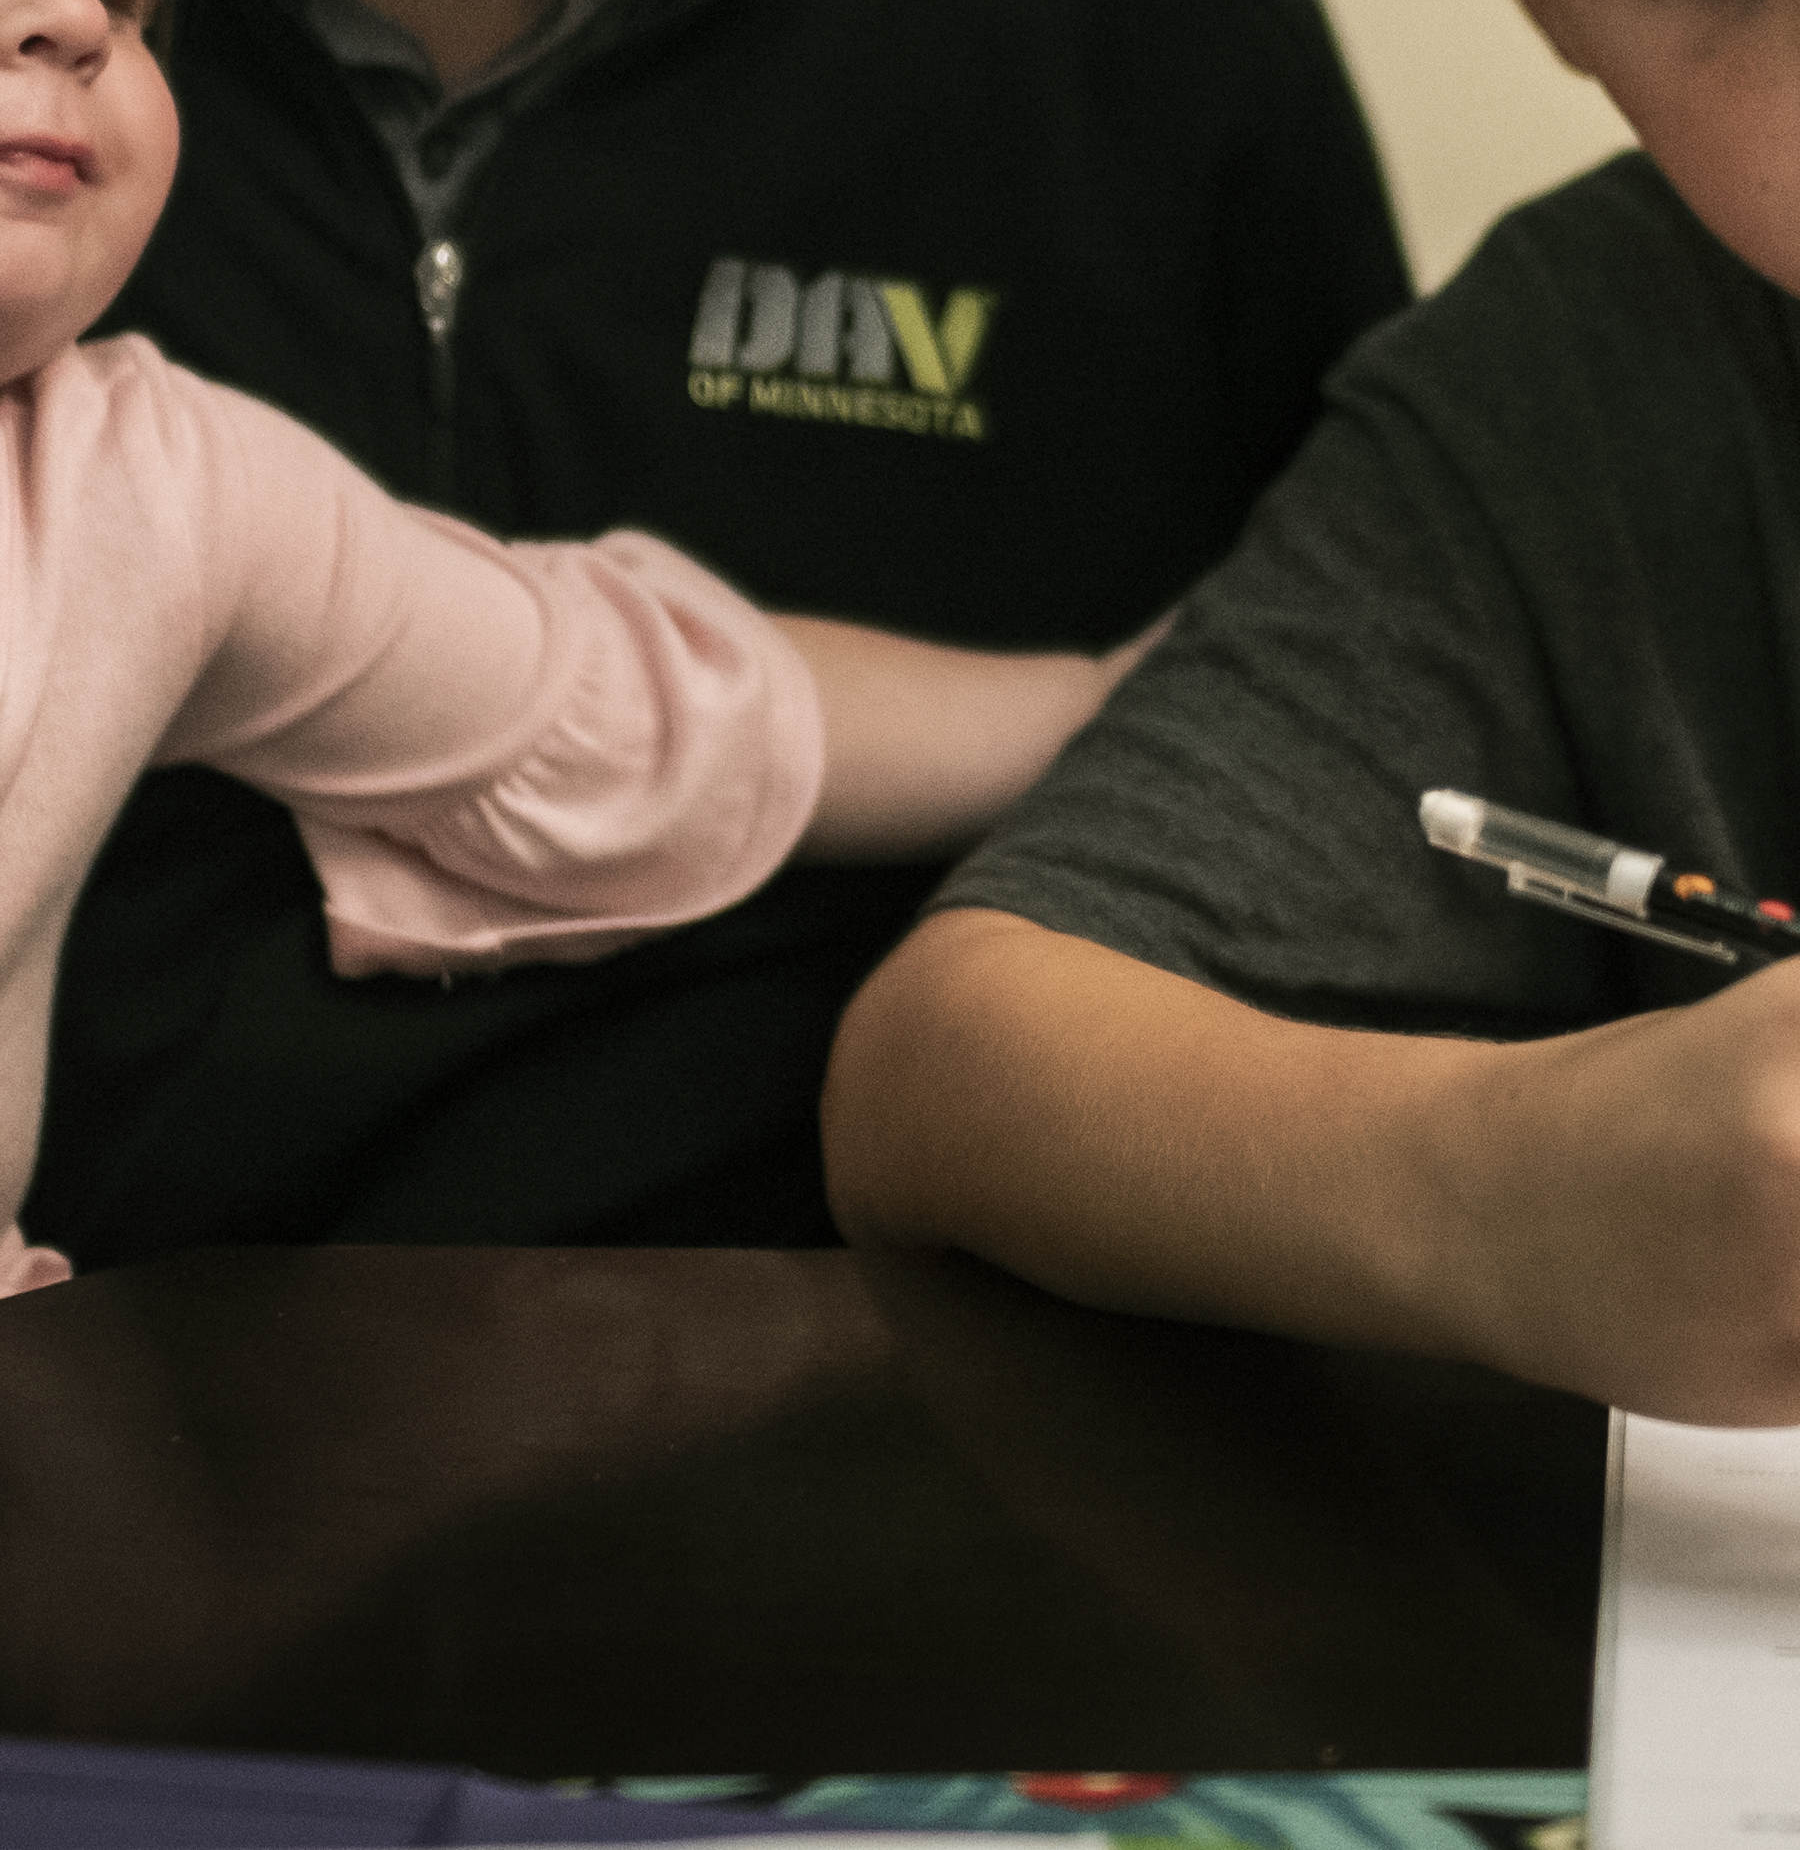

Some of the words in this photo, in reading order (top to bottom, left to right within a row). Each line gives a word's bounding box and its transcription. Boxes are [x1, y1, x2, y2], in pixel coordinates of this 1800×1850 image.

[689, 255, 998, 396] DAV
[687, 366, 746, 410] OF
[746, 373, 985, 441] MINNESOTA
